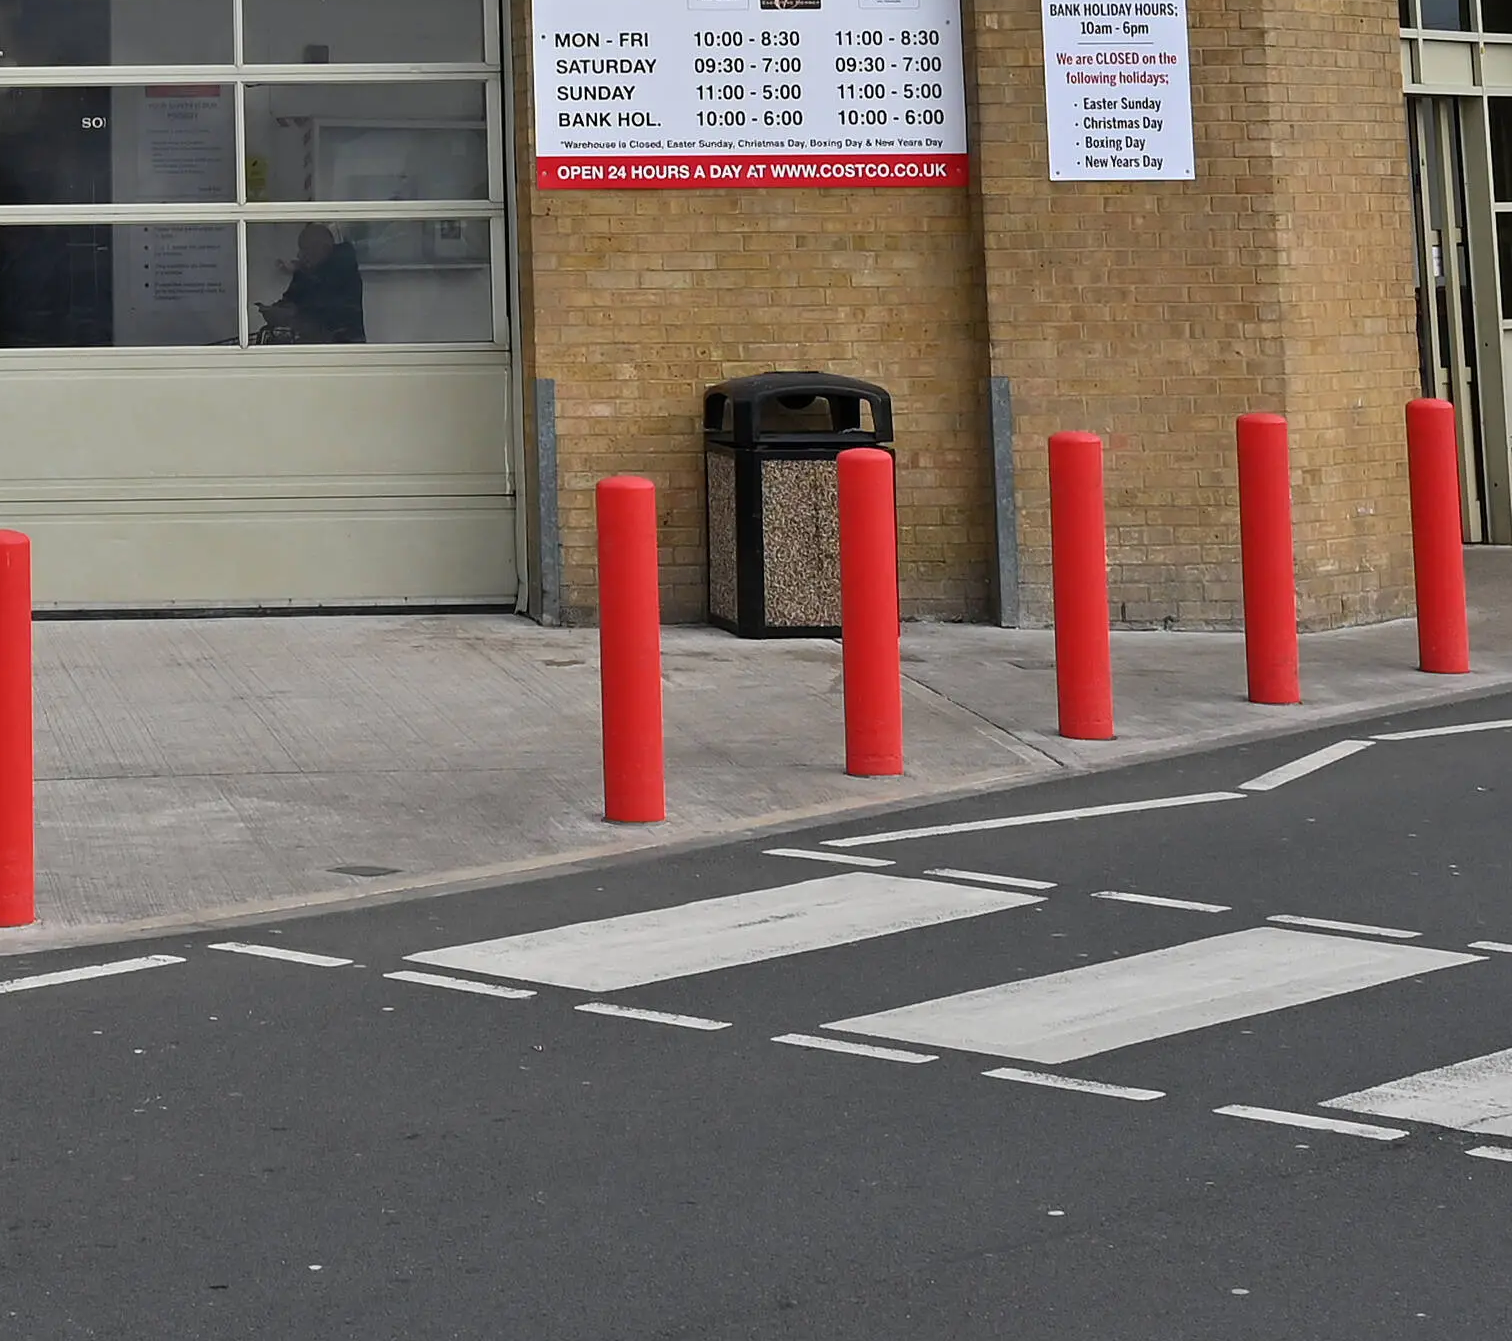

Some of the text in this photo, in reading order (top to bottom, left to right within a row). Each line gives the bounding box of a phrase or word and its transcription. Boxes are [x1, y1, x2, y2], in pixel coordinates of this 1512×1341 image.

[1050, 4, 1080, 17] BANK
[1084, 3, 1132, 16] HOLIDAY
[1081, 21, 1112, 34] 10am
[1123, 21, 1149, 37] 6pm
[554, 33, 599, 47] MON
[619, 33, 648, 47] FRI
[694, 32, 742, 46] 10:00
[761, 31, 800, 46] 8:30
[836, 31, 883, 45] 11:00
[901, 31, 939, 45] 8:30
[556, 59, 657, 73] SATURDAY
[694, 58, 744, 73] 09:30
[762, 58, 801, 72] 7:00
[836, 57, 885, 72] 09:30
[903, 57, 942, 72] 7:00
[1056, 52, 1176, 65] We are CLOSED on the
[1066, 72, 1116, 86] following
[557, 86, 635, 100] SUNDAY
[696, 85, 744, 100] 11:00
[762, 84, 801, 99] 5:00
[837, 84, 885, 99] 11:00
[903, 84, 942, 98] 5:00
[1083, 97, 1161, 112] Easter Sunday
[558, 113, 611, 127] BANK
[619, 112, 661, 127] HOL.
[697, 111, 745, 126] 10:00
[764, 110, 803, 125] 6:00
[839, 110, 887, 125] 10:00
[905, 110, 944, 125] 6:00
[1084, 117, 1163, 131] Christmas Day
[629, 141, 664, 149] Closed,
[698, 140, 735, 149] Sunday,
[738, 140, 784, 148] Christmas
[810, 139, 842, 149] Boxing
[845, 139, 862, 149] Day
[926, 139, 943, 148] Day
[1085, 136, 1146, 151] Boxing Day
[1085, 155, 1163, 170] New Years Day
[557, 163, 947, 179] OPEN 24 HOURS A DAY AT WWW.COSTCO.CO.UK
